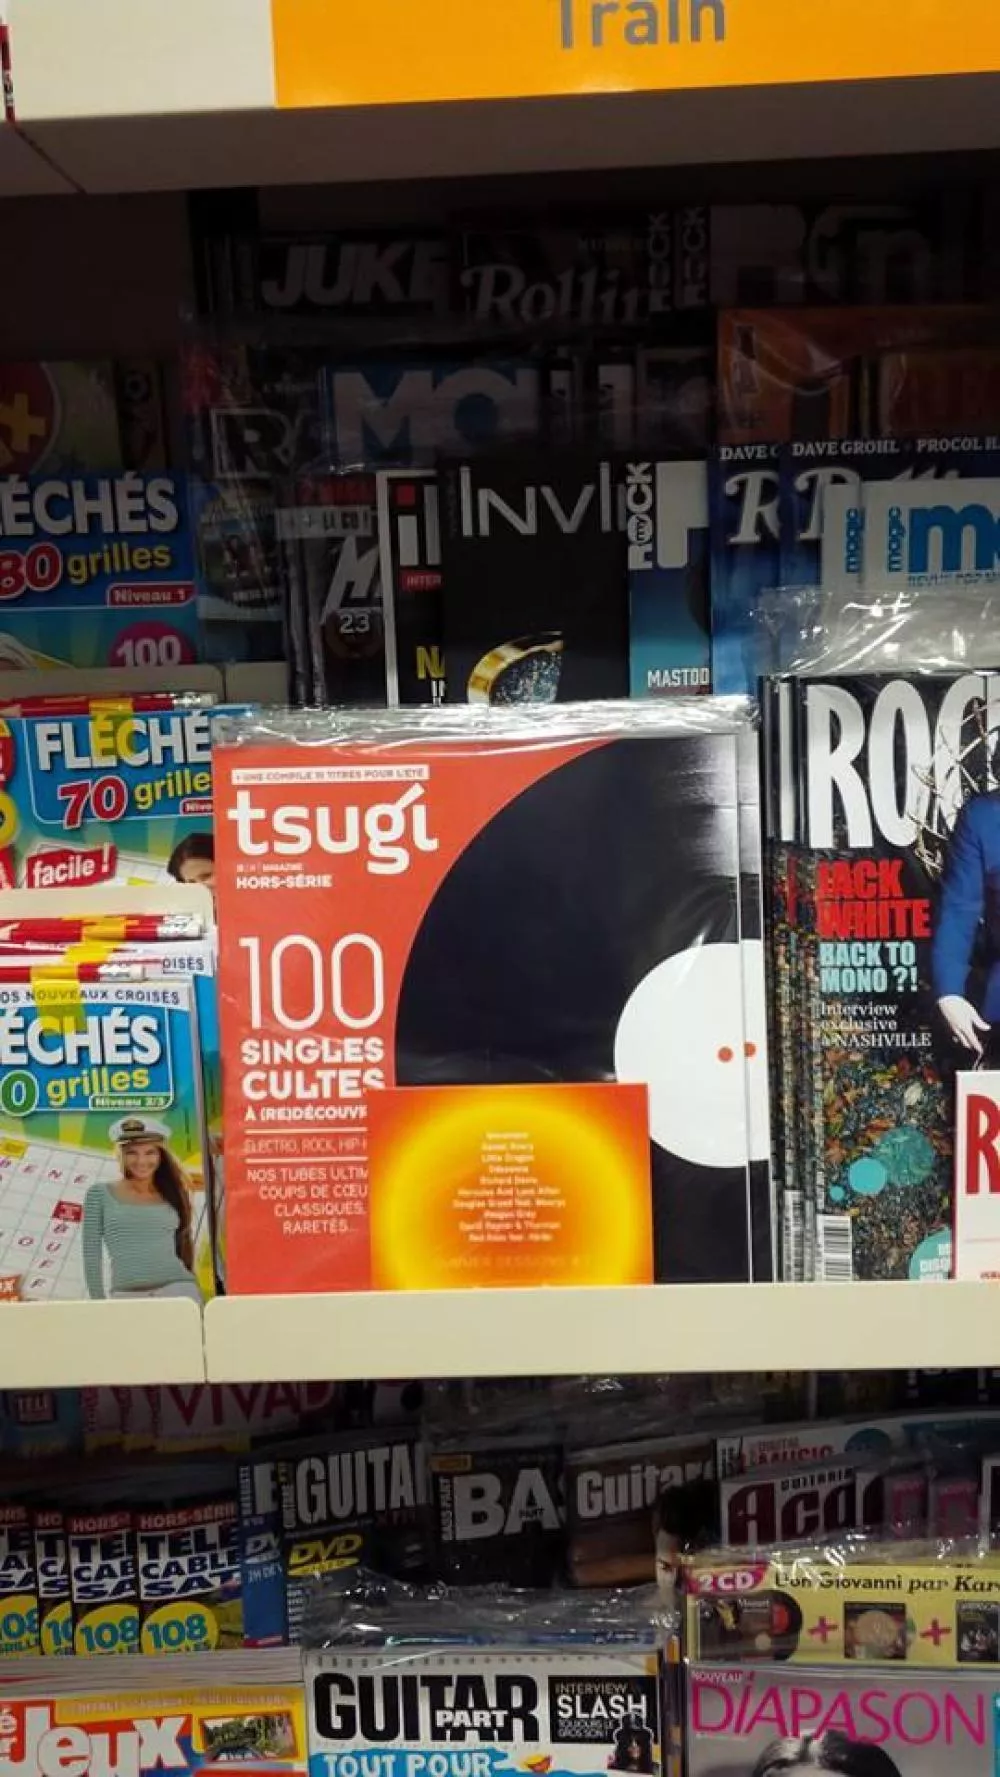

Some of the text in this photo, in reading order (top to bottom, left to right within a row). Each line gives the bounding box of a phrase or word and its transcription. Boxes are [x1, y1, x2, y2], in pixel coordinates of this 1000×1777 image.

[561, 0, 726, 49] Train
[792, 439, 900, 457] DAVE GROHL
[917, 437, 982, 453] PROCOL
[0, 471, 179, 537] ÉCHÉS
[67, 540, 172, 585] grilles
[113, 588, 172, 604] Niveau
[339, 612, 371, 637] 23
[116, 634, 182, 667] 100
[35, 711, 213, 771] FLÉCHÉ
[57, 775, 128, 830] 70
[227, 782, 440, 876] tsugi
[33, 854, 96, 889] facile
[236, 872, 333, 890] HORS-SÉRIE
[817, 858, 905, 899] JACK
[817, 898, 932, 939] WHITE
[820, 940, 916, 967] BACK TO
[238, 933, 385, 1031] 100
[820, 967, 889, 994] MONO
[26, 988, 109, 1002] NOUVEAUX
[820, 1000, 899, 1017] Interview
[820, 1017, 898, 1032] exclusive
[240, 1036, 385, 1065] SINGLES
[834, 1032, 933, 1048] NASHVILLE
[46, 1066, 149, 1107] grilles
[241, 1067, 386, 1101] CULTES
[247, 1168, 277, 1183] NOS
[280, 1167, 327, 1182] TUBES
[259, 1184, 306, 1200] COUPS
[310, 1183, 328, 1199] DE
[453, 1466, 568, 1541] BA
[288, 1531, 366, 1566] DVD
[819, 1572, 903, 1590] Giovanni
[907, 1577, 949, 1594] par
[81, 1616, 138, 1651] 108
[148, 1613, 207, 1648] 108
[555, 1682, 628, 1695] INTERVIEW
[691, 1671, 743, 1682] NOUVEAU
[314, 1673, 540, 1743] GUITAR
[436, 1709, 508, 1728] PART
[557, 1694, 648, 1719] SLASH
[323, 1753, 491, 1777] TOUT POUR
